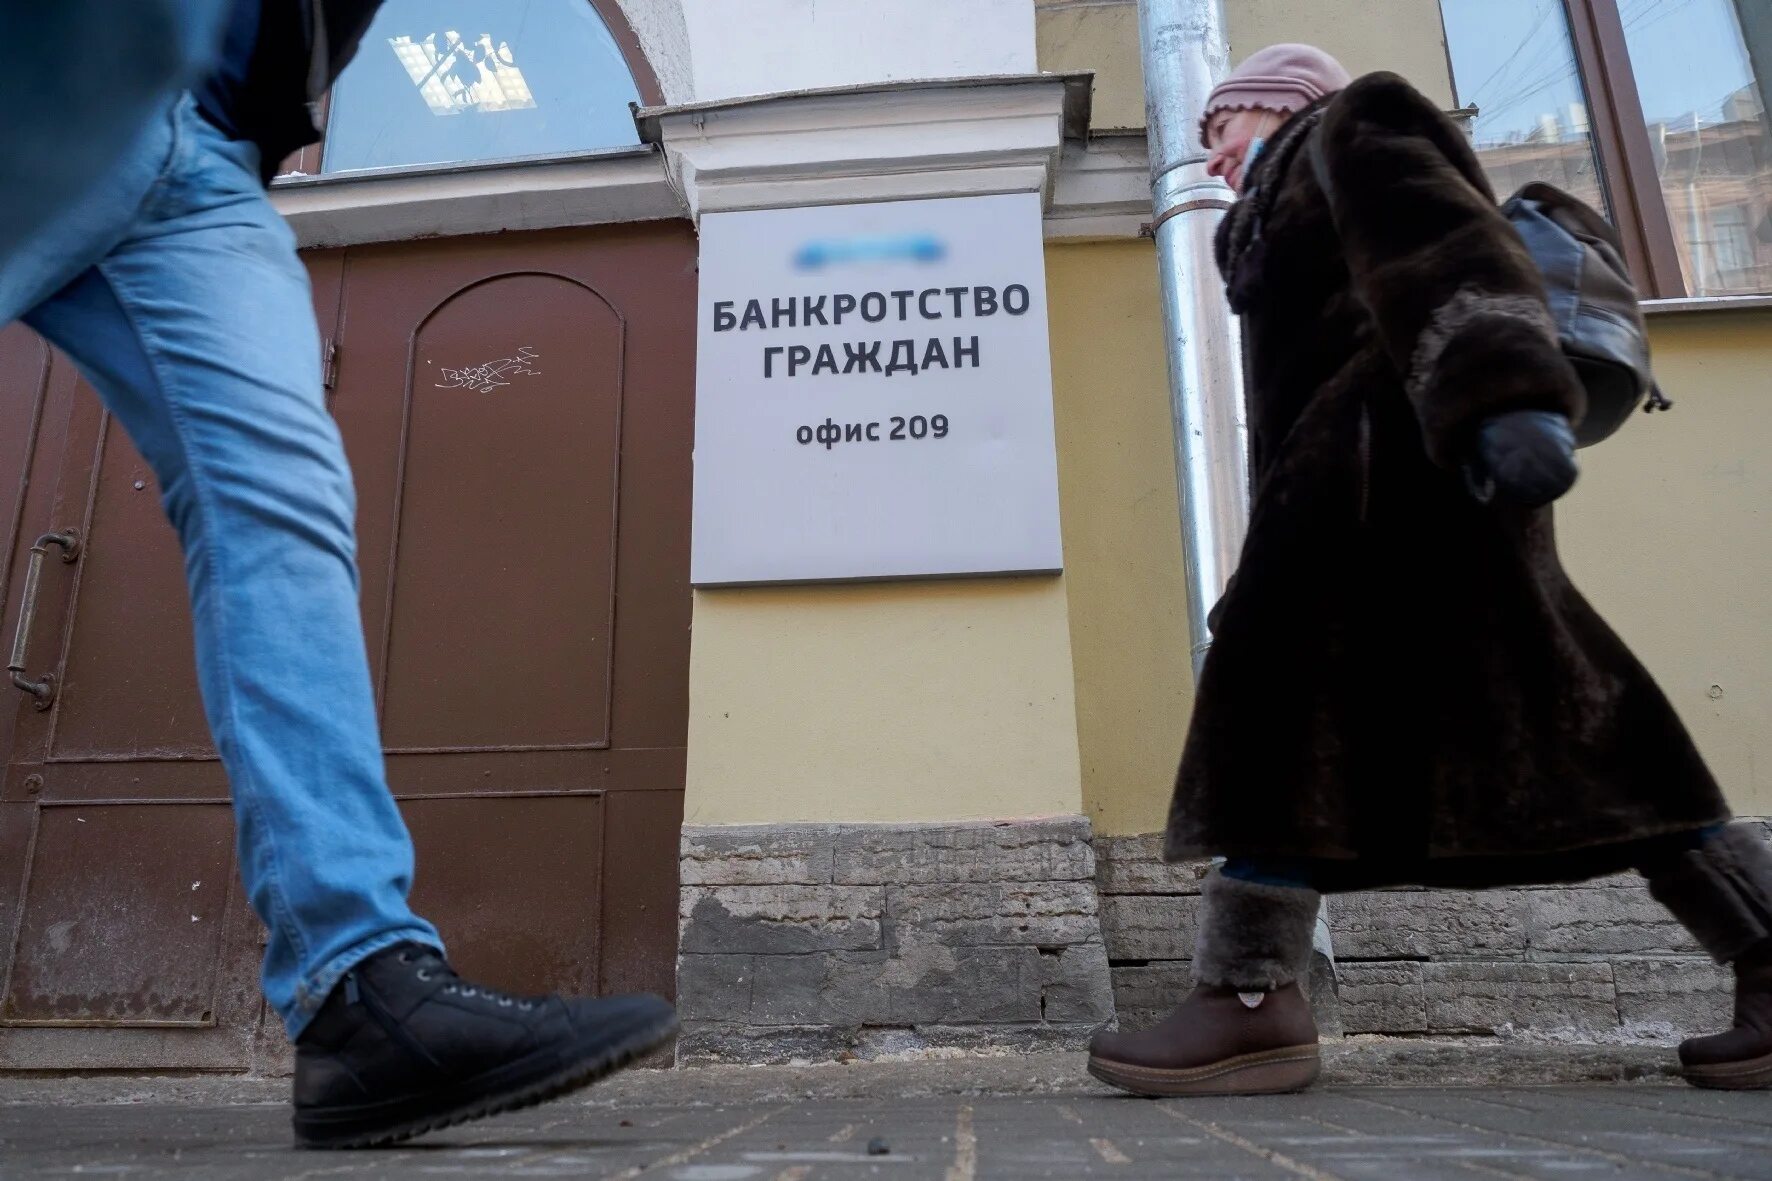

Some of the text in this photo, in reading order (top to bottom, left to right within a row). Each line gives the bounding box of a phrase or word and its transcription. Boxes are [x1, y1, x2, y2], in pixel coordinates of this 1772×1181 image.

[713, 283, 1030, 332] БАНКРОТСТВО
[764, 335, 980, 379] ГРАЖДАН
[796, 413, 949, 450] офис 209
